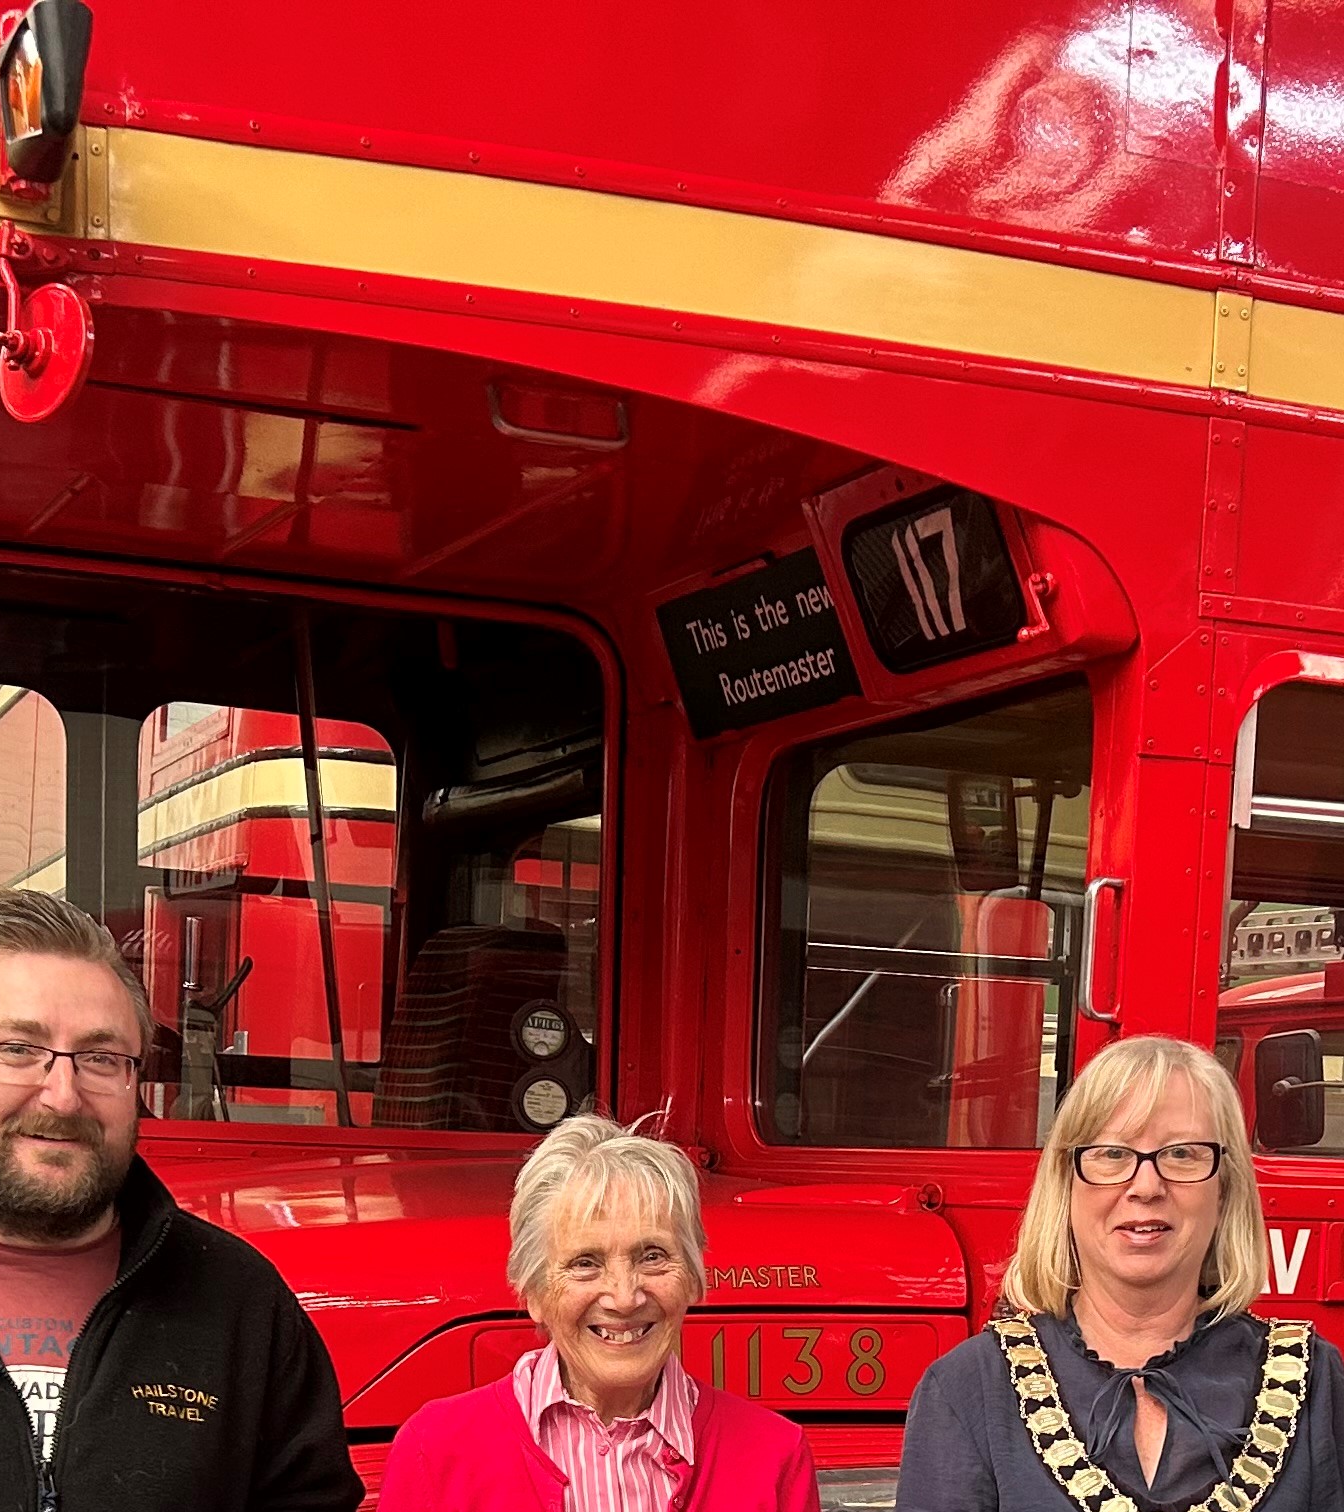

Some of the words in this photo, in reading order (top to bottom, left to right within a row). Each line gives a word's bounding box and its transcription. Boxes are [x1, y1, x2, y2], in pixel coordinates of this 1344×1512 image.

[891, 506, 966, 641] 117
[685, 616, 728, 656] This
[730, 608, 751, 641] is
[755, 595, 790, 633] the
[795, 582, 836, 619] new
[718, 646, 837, 707] Routemaster
[130, 1383, 219, 1411] HAILSTONE
[146, 1401, 205, 1423] TRAVEL
